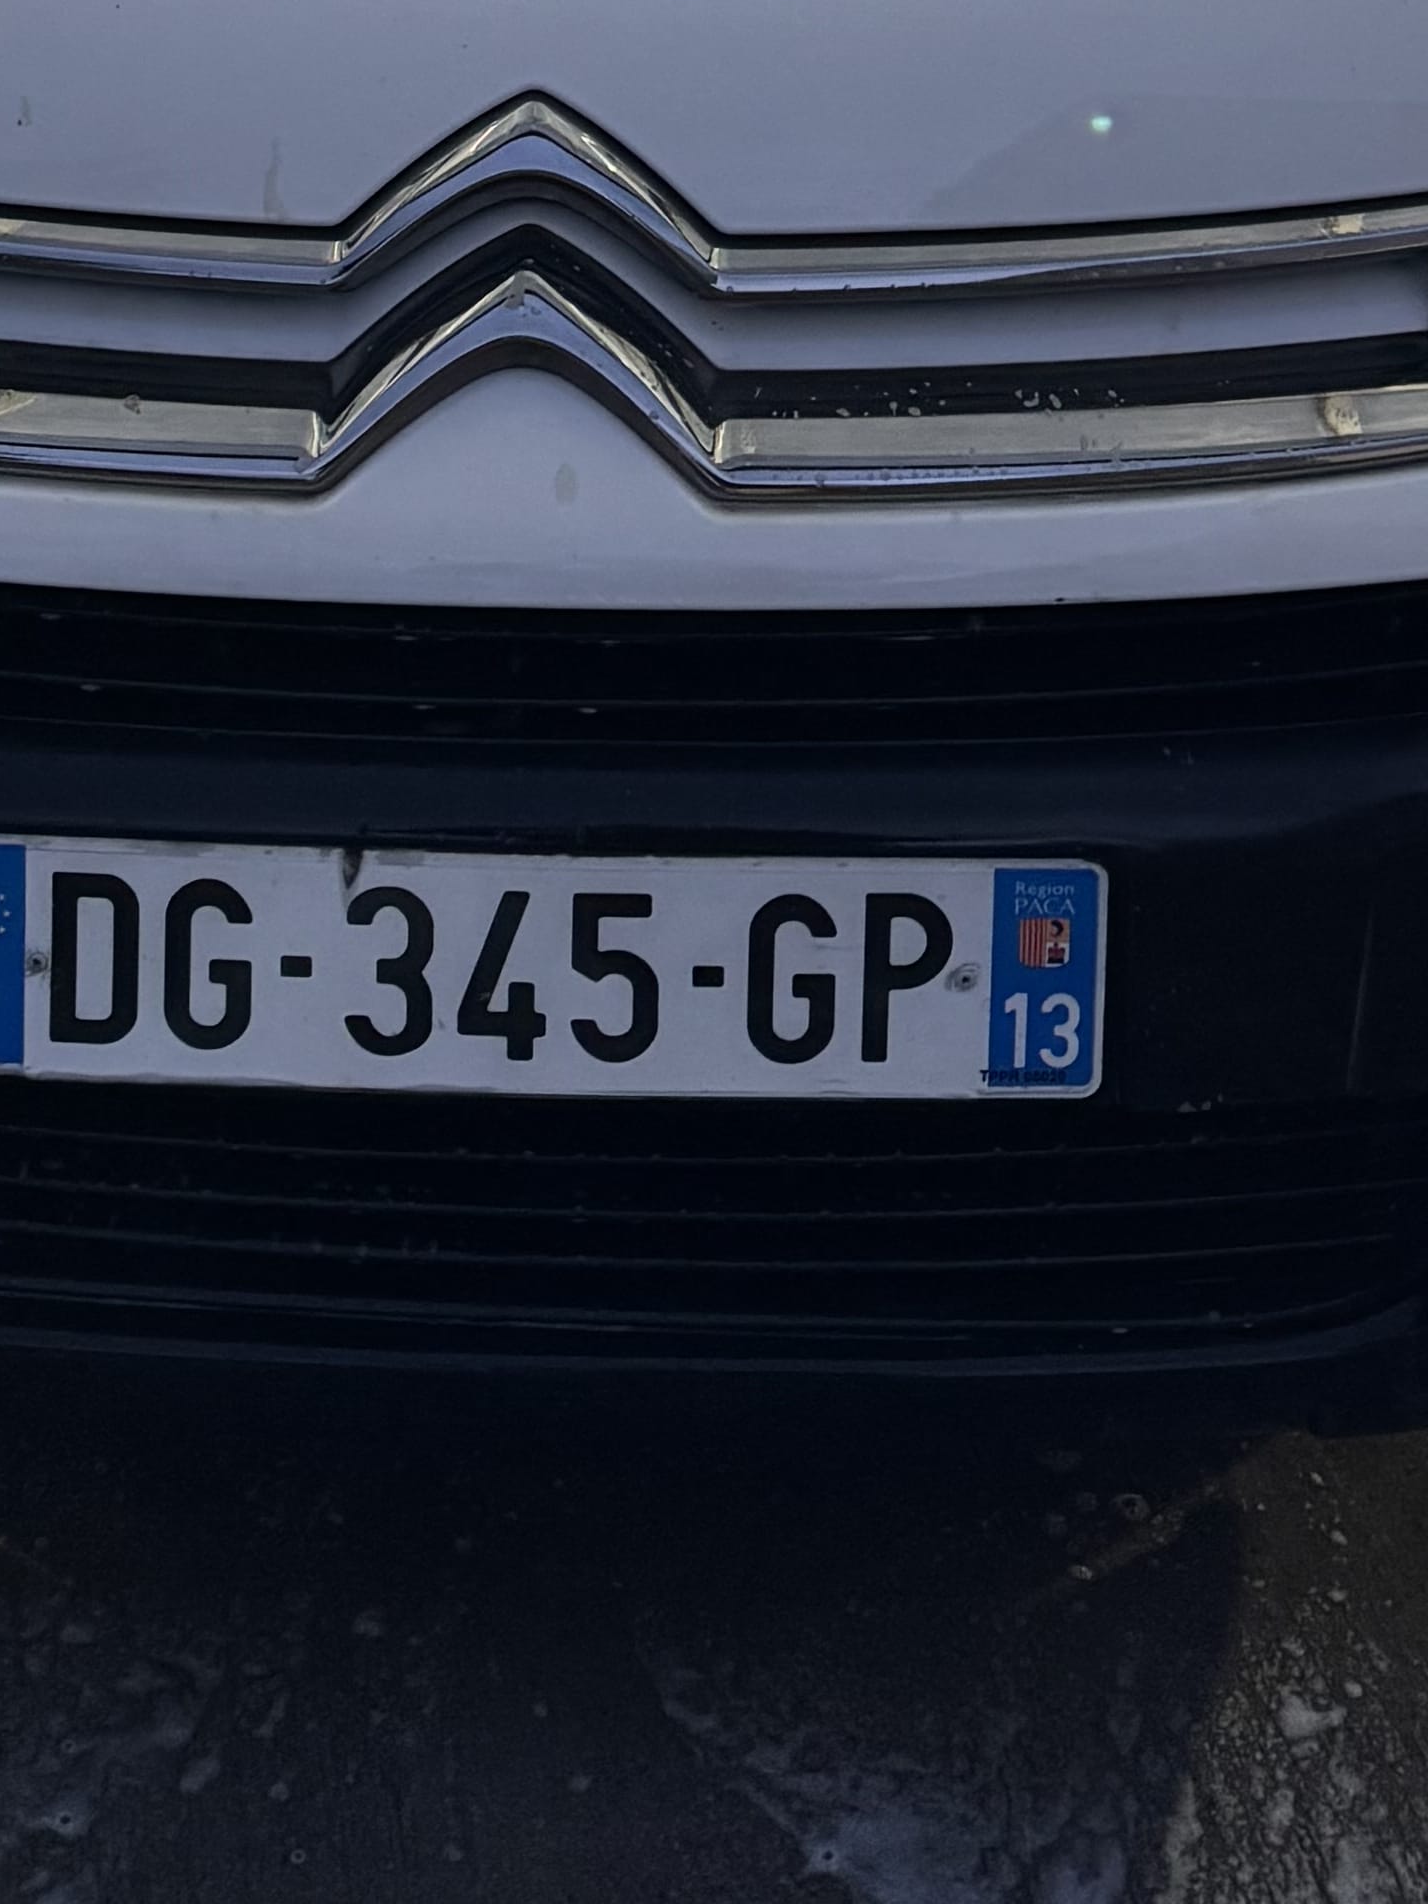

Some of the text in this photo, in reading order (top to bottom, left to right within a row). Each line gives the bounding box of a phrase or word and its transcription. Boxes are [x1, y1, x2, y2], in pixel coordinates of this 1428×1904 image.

[1014, 897, 1076, 915] PACA
[49, 870, 953, 1066] DG-345-GP
[1004, 991, 1080, 1069] 13
